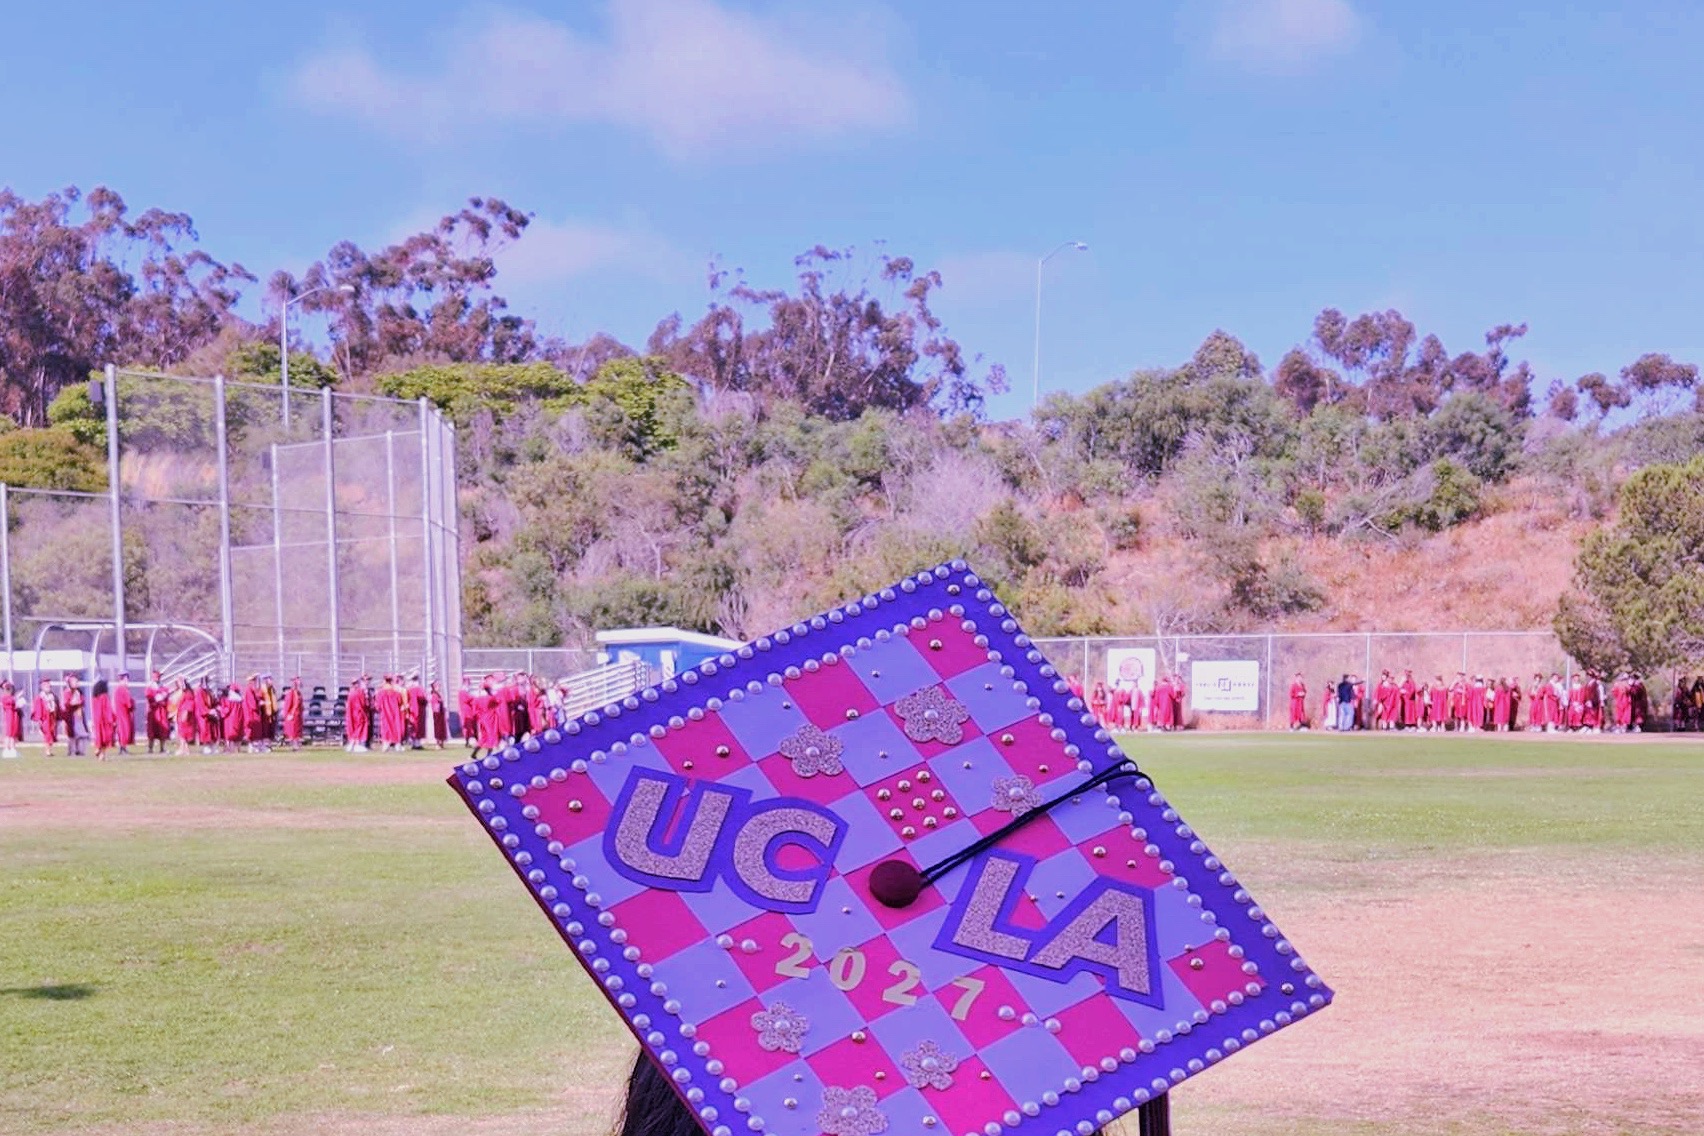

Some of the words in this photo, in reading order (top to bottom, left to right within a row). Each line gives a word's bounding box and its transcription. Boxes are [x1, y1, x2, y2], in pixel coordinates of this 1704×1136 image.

[612, 776, 839, 905] UC
[950, 854, 1152, 997] LA
[774, 931, 986, 1022] 2027
